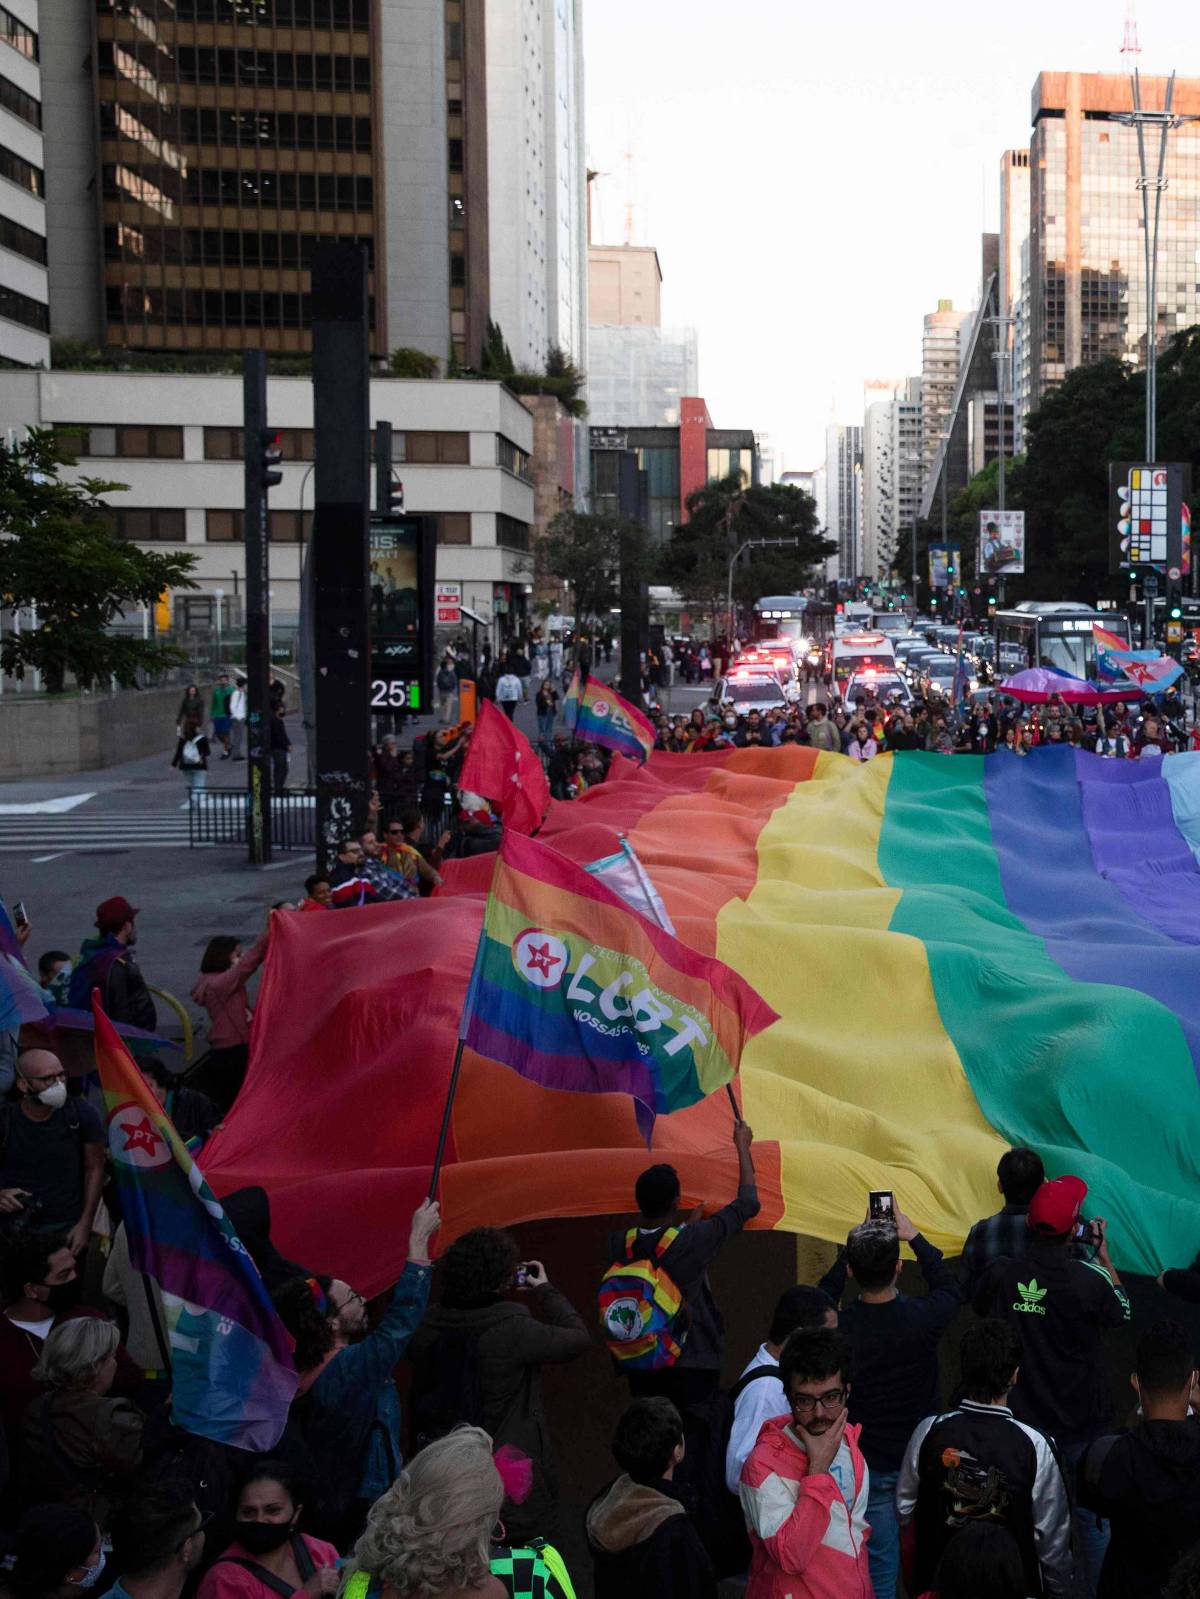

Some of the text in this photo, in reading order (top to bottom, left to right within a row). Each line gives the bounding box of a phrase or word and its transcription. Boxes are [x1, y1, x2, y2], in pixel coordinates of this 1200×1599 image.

[370, 680, 406, 707] 25
[534, 953, 551, 967] PT
[566, 953, 709, 1057] LGBT
[573, 1008, 621, 1037] NOSSAS
[133, 1130, 155, 1144] PT
[1012, 1301, 1046, 1315] adidas
